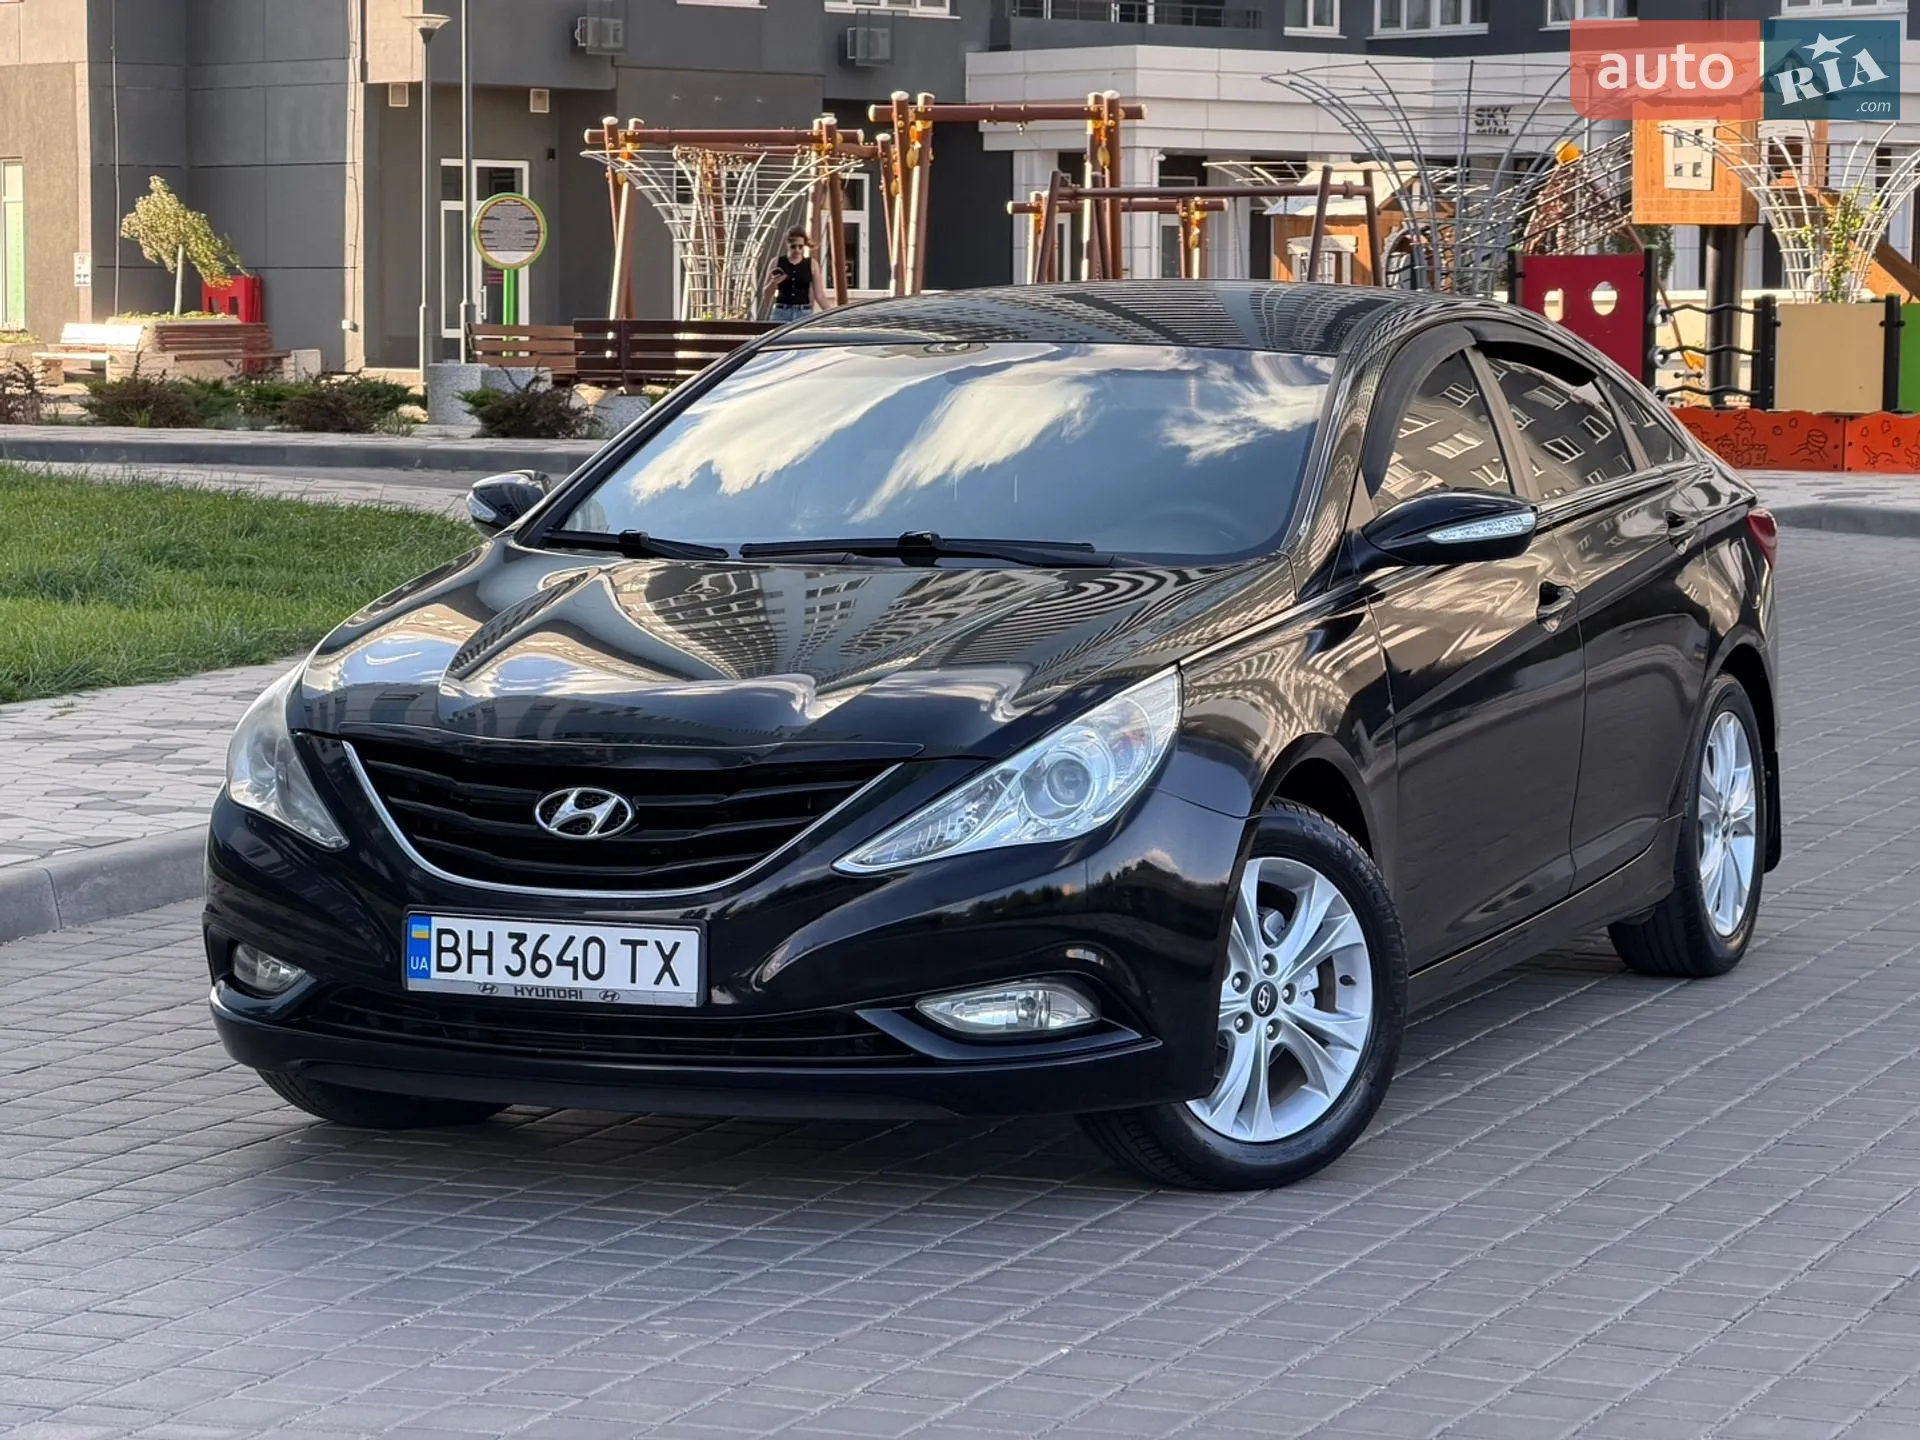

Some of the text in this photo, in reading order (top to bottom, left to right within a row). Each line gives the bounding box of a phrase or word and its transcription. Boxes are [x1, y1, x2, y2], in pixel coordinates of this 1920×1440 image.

[1474, 106, 1511, 126] SKY
[410, 956, 429, 971] UA
[436, 928, 681, 987] BH 3640 TX
[513, 984, 583, 1000] HYUNDAI
